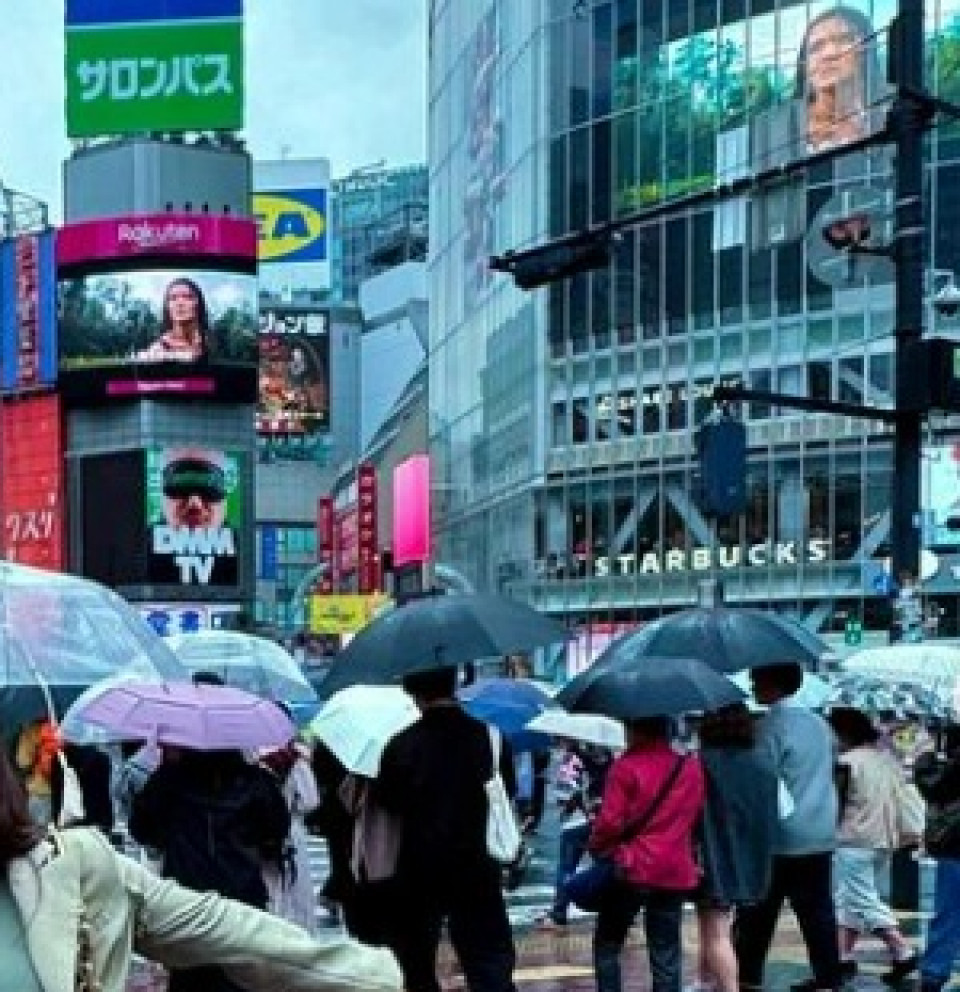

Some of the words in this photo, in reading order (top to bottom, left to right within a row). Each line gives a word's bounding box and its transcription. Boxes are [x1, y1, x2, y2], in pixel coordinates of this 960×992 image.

[76, 54, 234, 100] サロンパス
[117, 221, 200, 247] Rakuten
[5, 510, 54, 542] クスリ
[152, 526, 235, 555] DMM
[173, 556, 215, 586] TV
[594, 538, 833, 578] STARBUCKS
